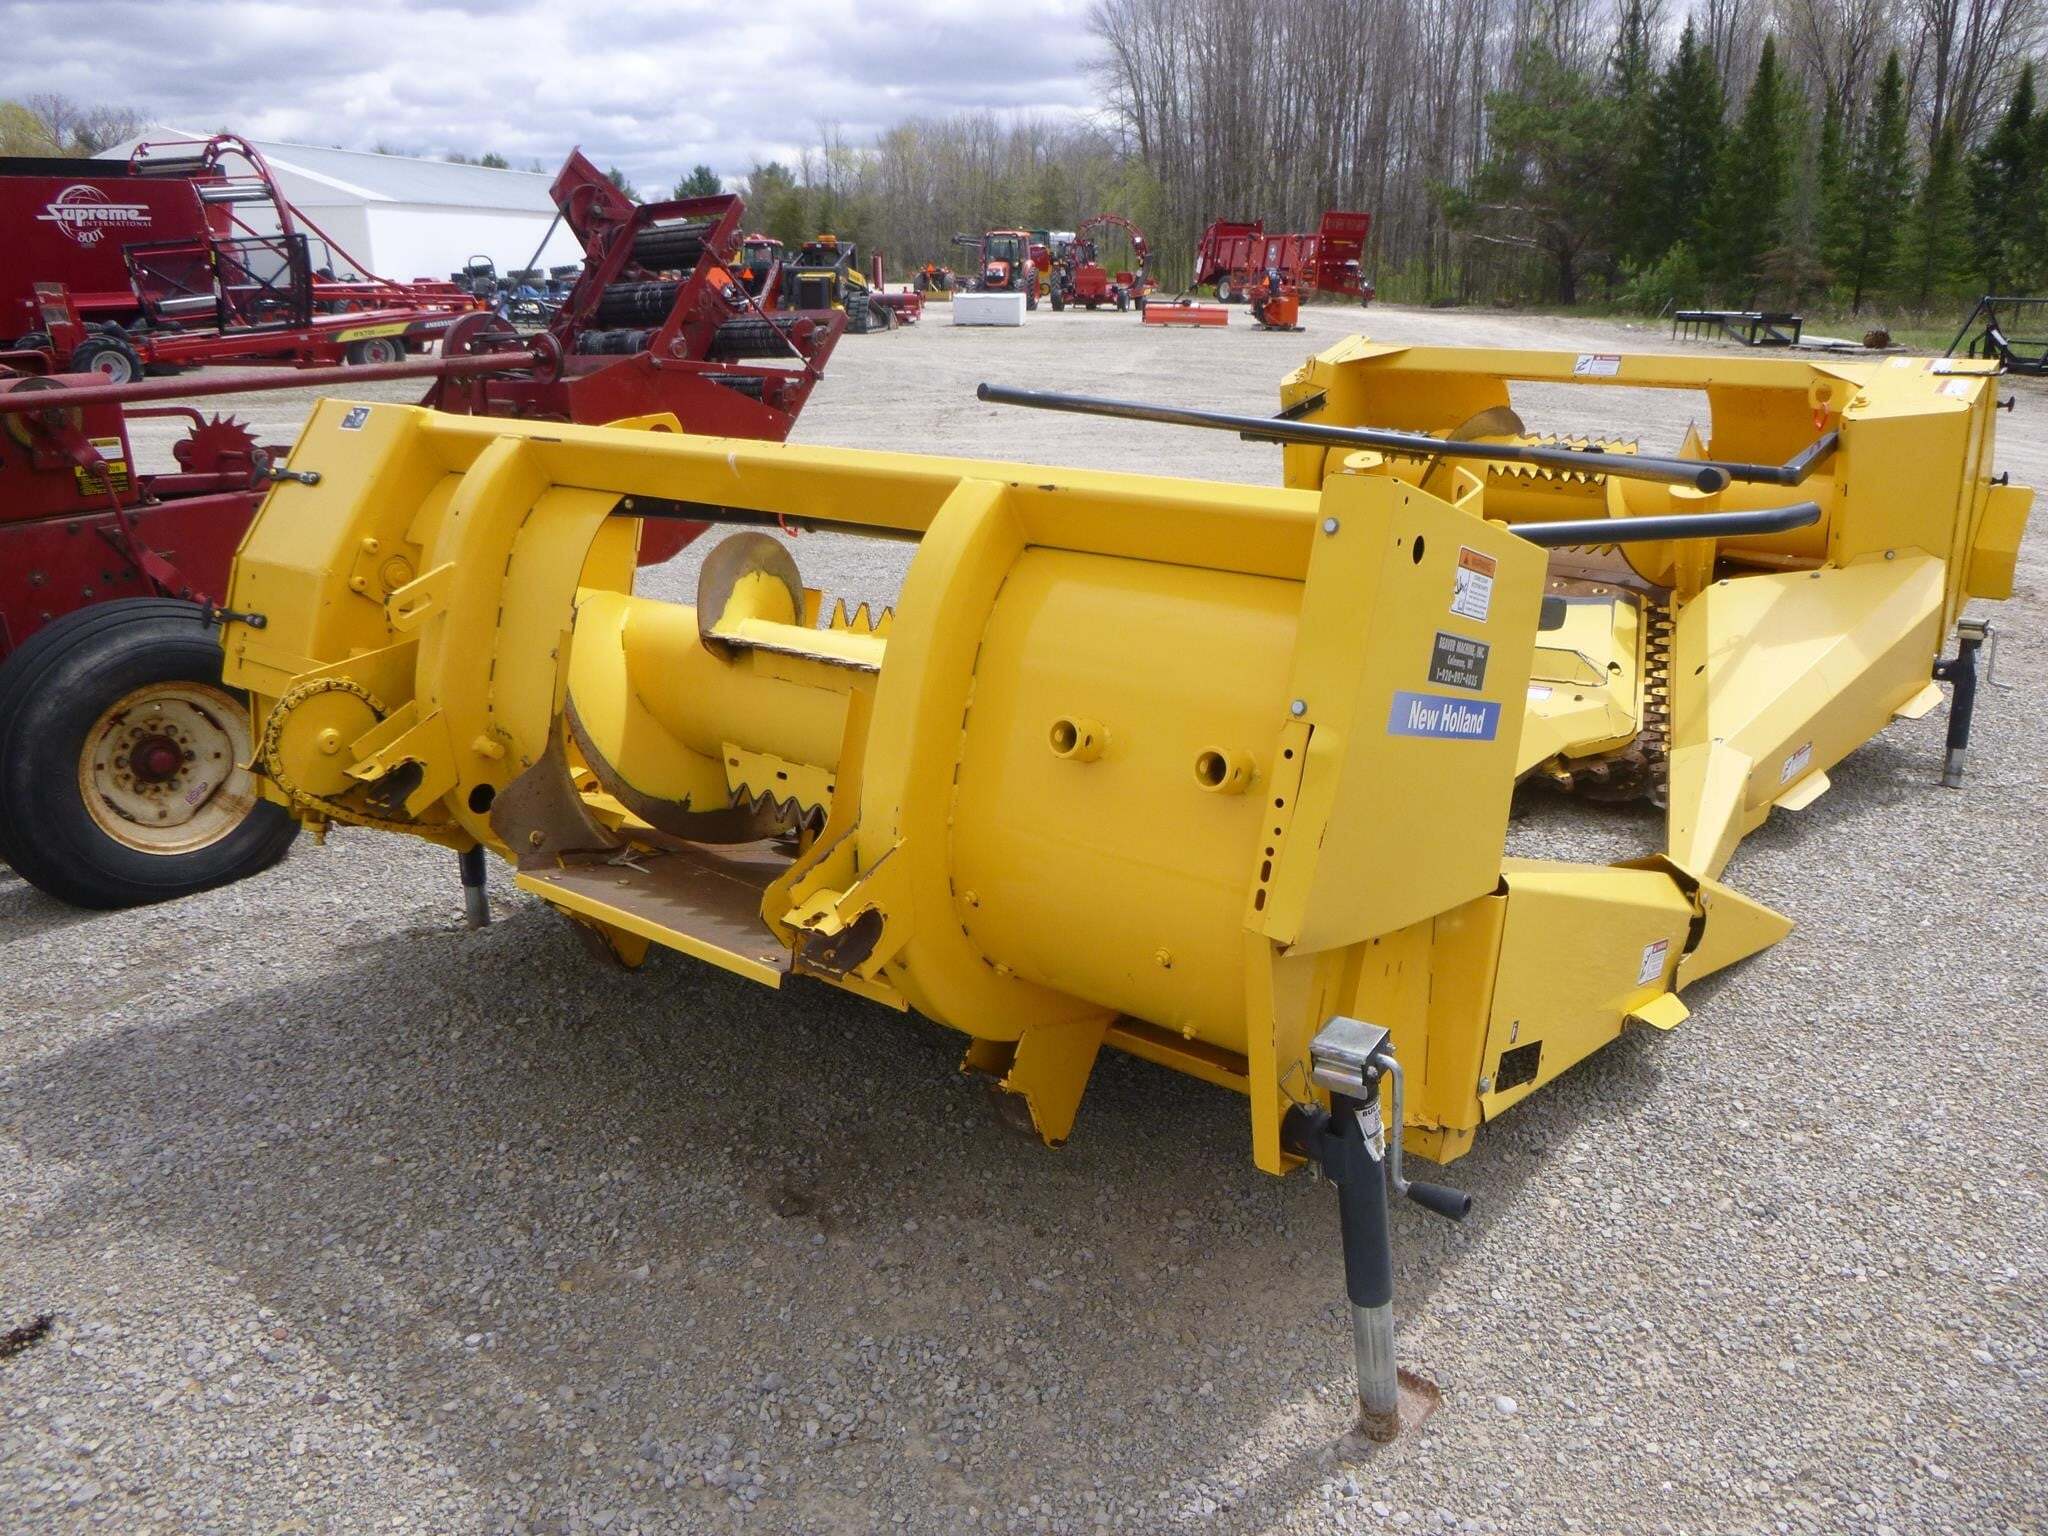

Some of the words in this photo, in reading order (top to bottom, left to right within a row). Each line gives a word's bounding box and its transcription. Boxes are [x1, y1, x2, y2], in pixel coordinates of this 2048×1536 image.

[37, 204, 152, 227] Supreme
[1408, 701, 1439, 731] New
[1440, 704, 1486, 734] Holland
